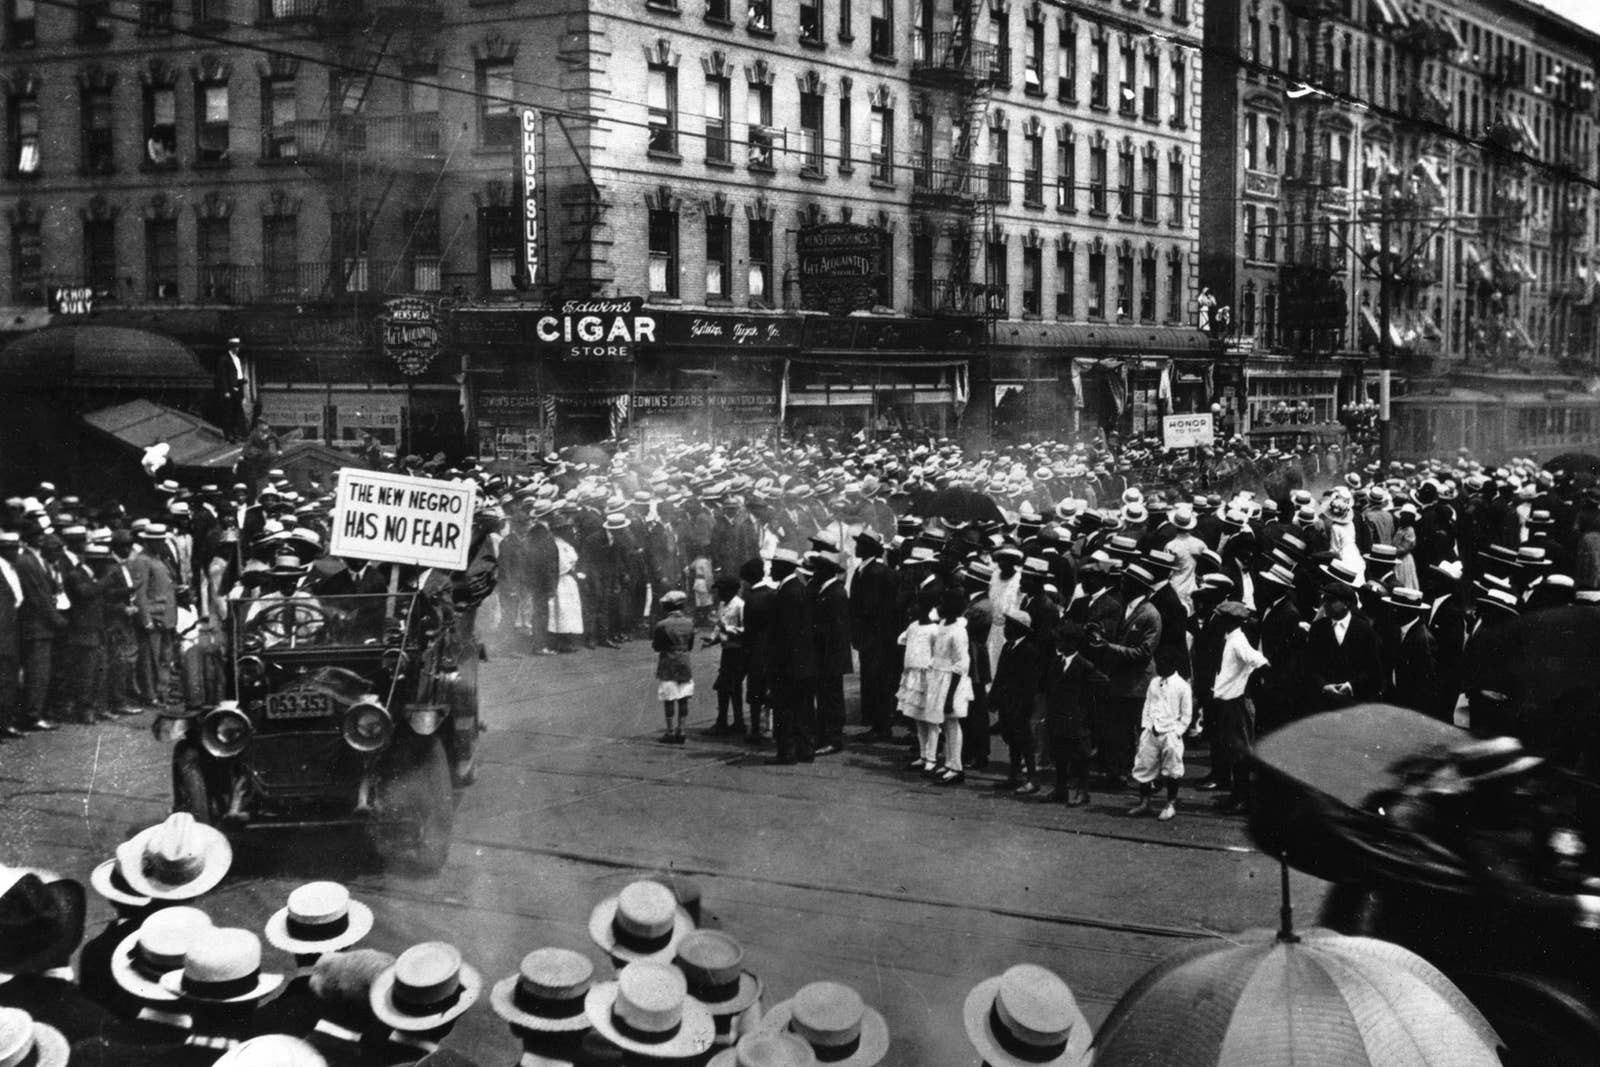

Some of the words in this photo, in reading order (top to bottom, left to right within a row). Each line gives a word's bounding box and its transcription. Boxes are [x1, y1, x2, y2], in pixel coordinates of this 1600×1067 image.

[523, 110, 536, 197] CHOP
[526, 198, 538, 284] SUEY
[62, 288, 92, 301] CHOP
[60, 301, 92, 314] SUEY
[561, 300, 632, 313] Edwin's
[536, 316, 656, 342] CIGAR
[571, 346, 628, 357] STORE
[632, 394, 668, 408] EDWIN'S
[669, 394, 705, 407] CIGARS
[1168, 419, 1206, 428] HONOR
[349, 482, 374, 503] THE
[378, 486, 405, 506] NEW
[408, 490, 462, 514] NEGRO
[344, 510, 378, 540] HAS
[384, 515, 407, 543] NO
[412, 518, 460, 550] FEAR
